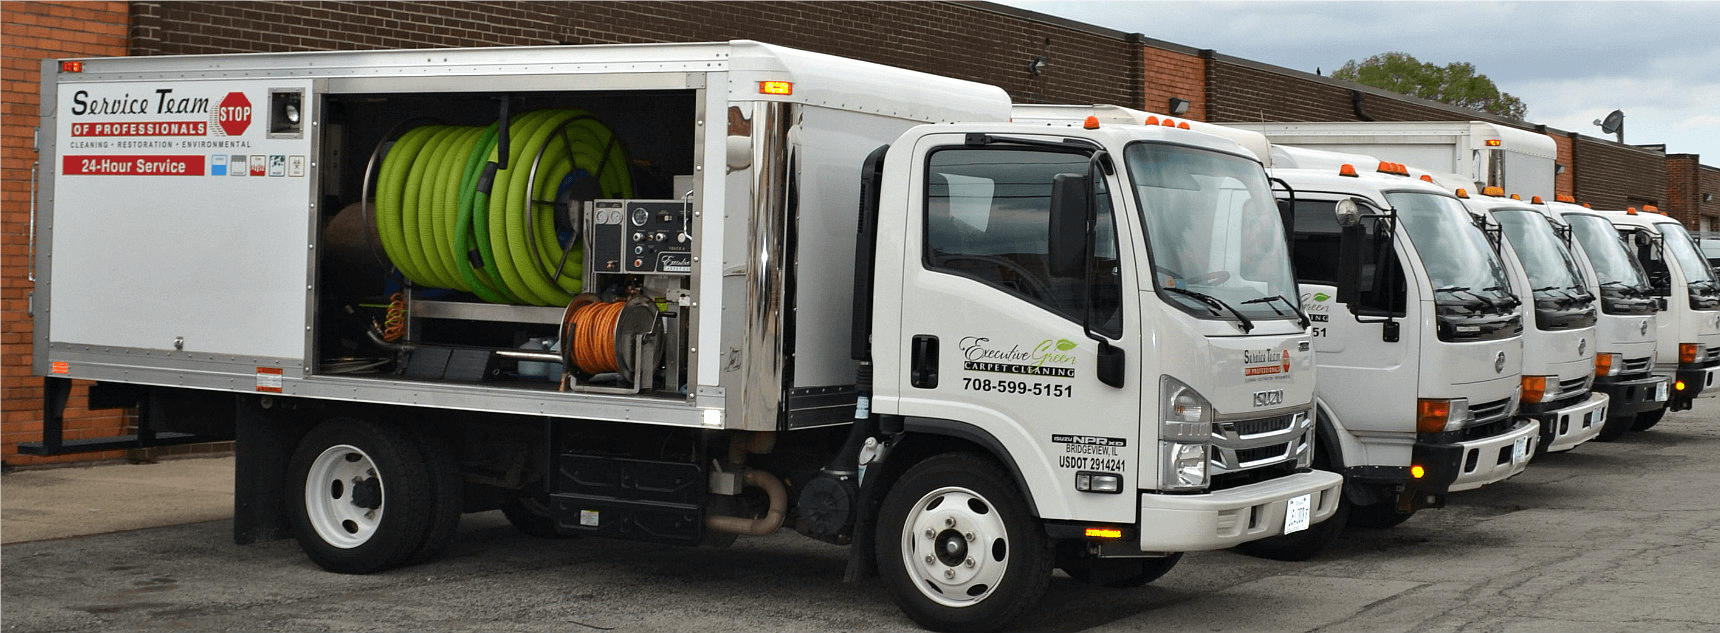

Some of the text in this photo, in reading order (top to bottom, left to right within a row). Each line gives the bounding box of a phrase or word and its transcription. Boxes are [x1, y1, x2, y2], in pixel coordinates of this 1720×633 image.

[72, 89, 209, 116] Service Team
[219, 106, 251, 122] STOP
[73, 123, 205, 135] OF PROFESSIONALS
[70, 141, 109, 149] CLEANING
[117, 141, 173, 149] RESTORATION
[81, 159, 186, 173] 24-Hour Service
[959, 336, 1077, 372] Executive Green
[964, 361, 1075, 377] CARPET CLEANING
[963, 377, 1072, 398] 708-599-5151
[1253, 389, 1283, 408] ISUZU
[1073, 436, 1108, 445] NPR
[1066, 444, 1111, 457] BRIDGEVIEW,
[1059, 456, 1125, 472] USDOT 2914241
